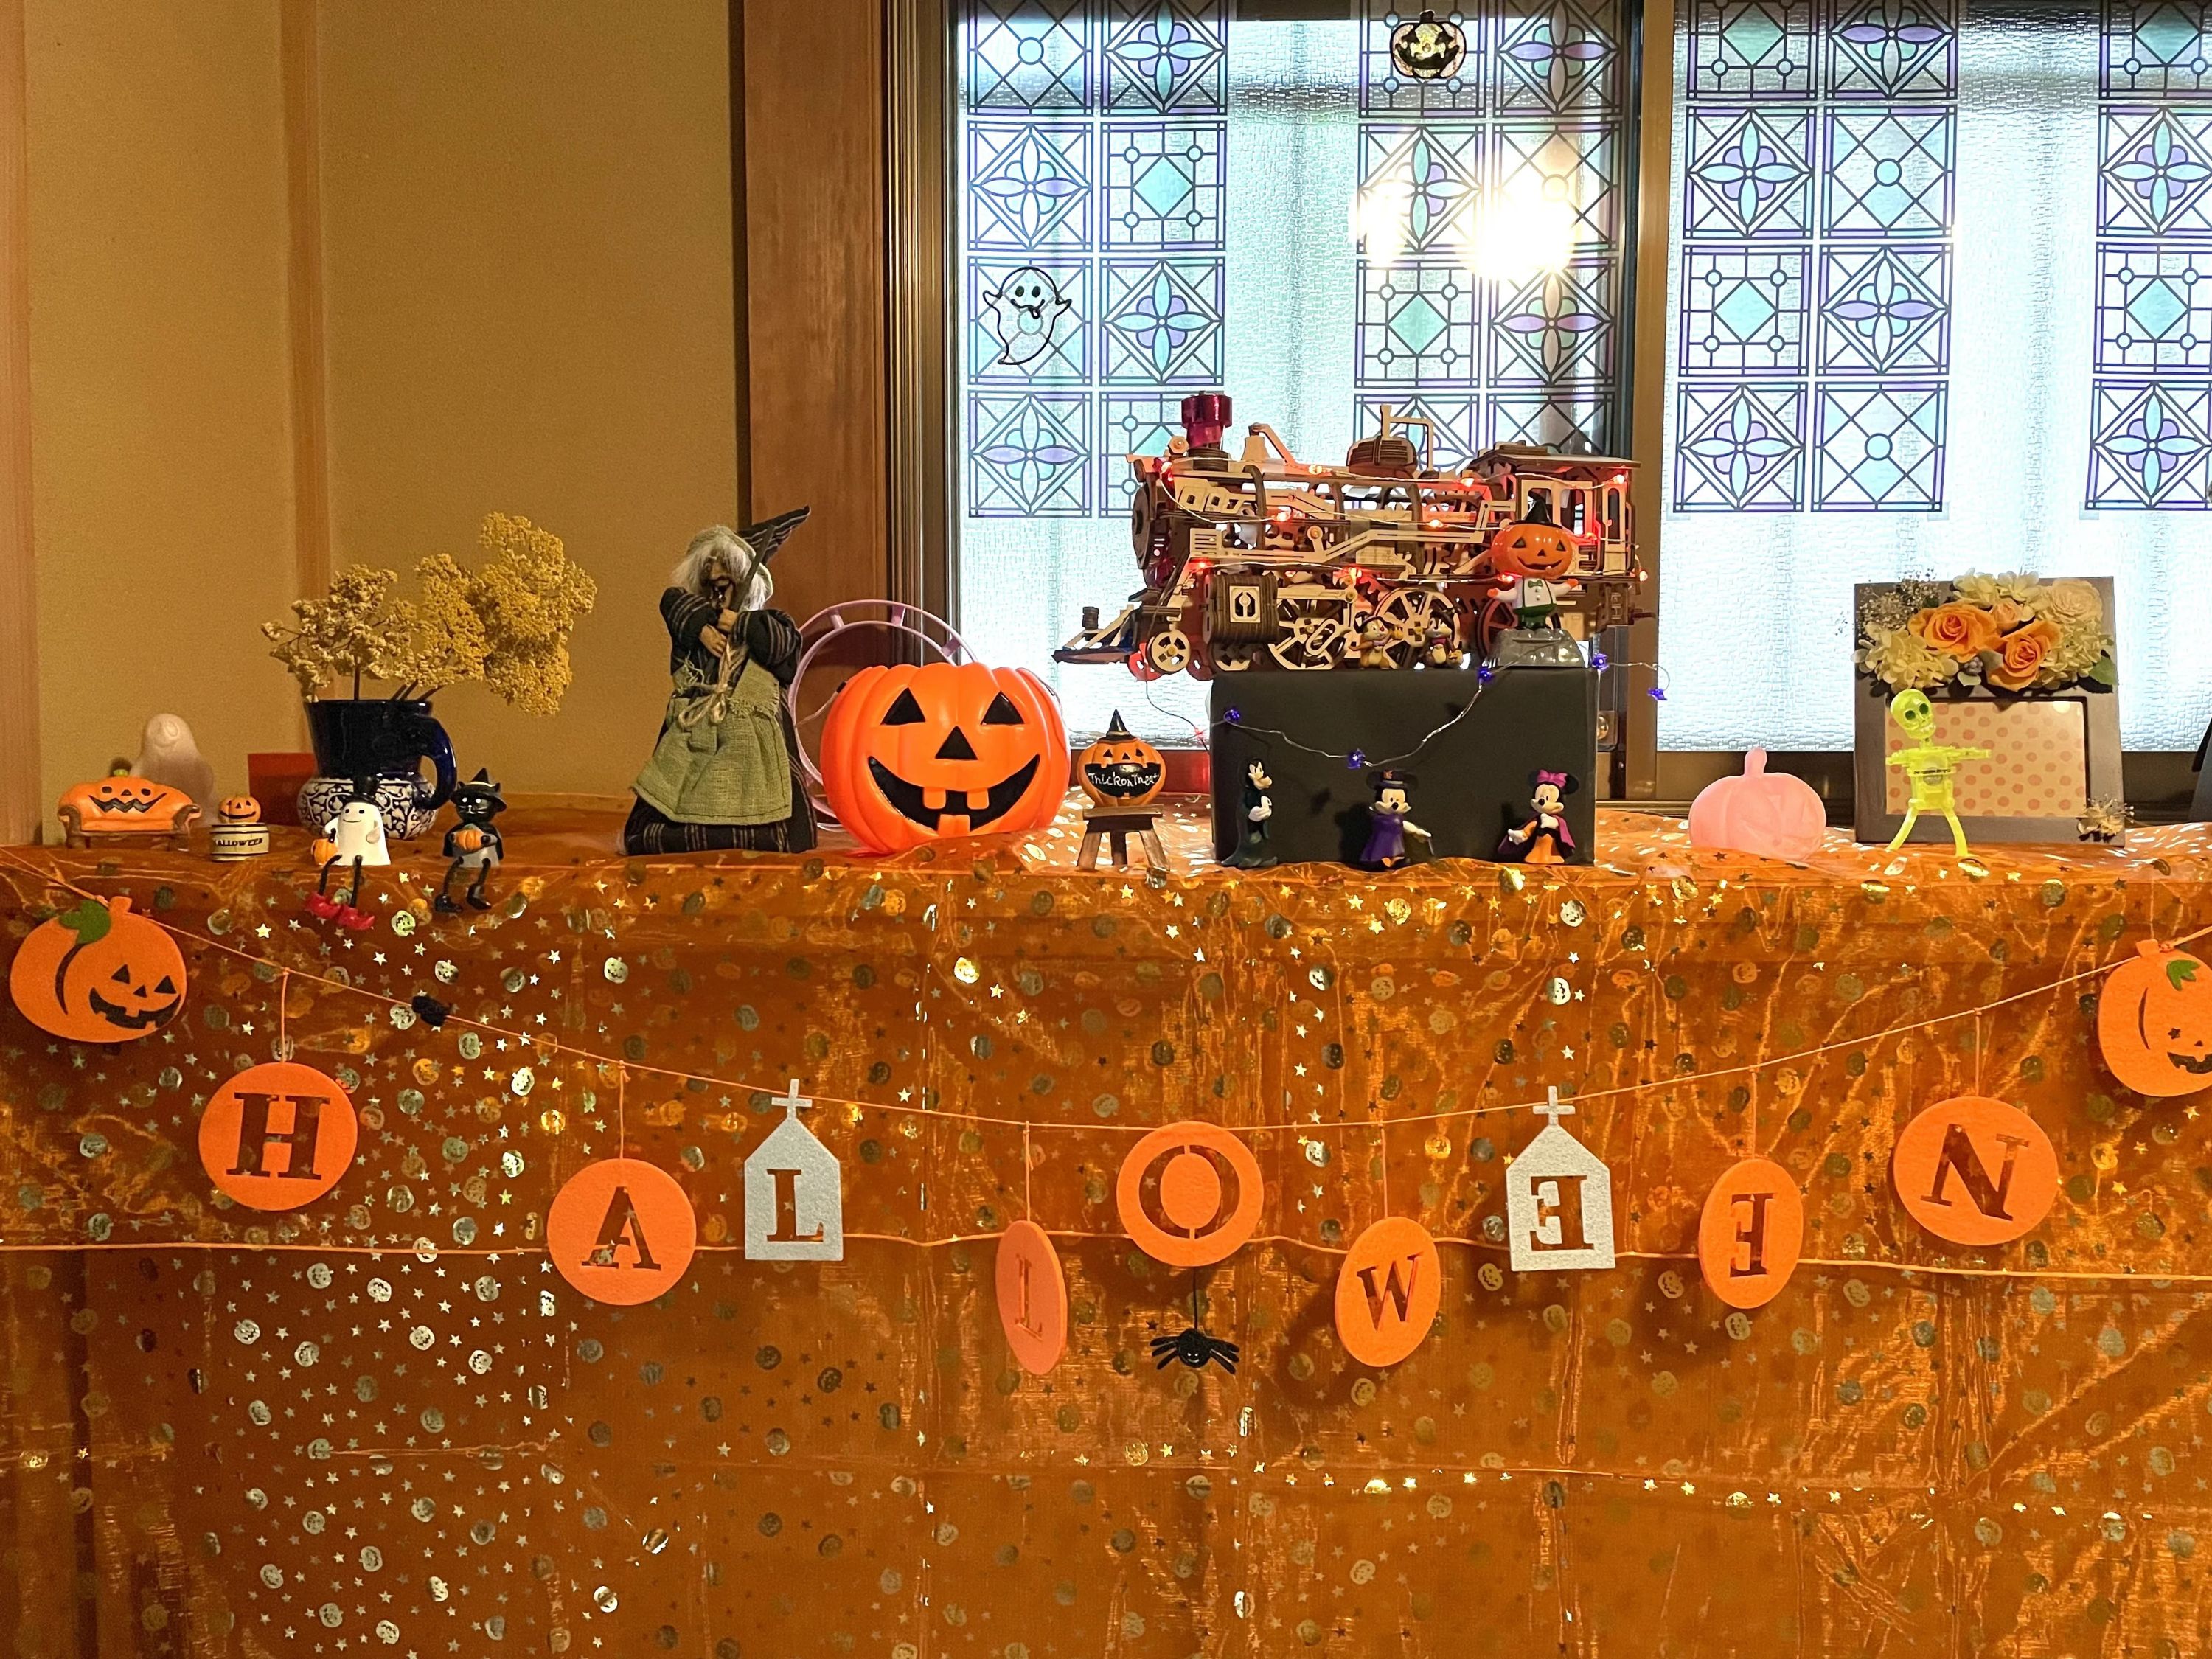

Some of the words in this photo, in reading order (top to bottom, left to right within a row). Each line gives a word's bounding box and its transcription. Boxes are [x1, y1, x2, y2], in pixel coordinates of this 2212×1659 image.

[215, 838, 263, 846] ALLOWEEN
[226, 1091, 330, 1180] H
[580, 1186, 662, 1271] A
[766, 1168, 824, 1243] L
[1139, 1144, 1241, 1239] O
[1357, 1253, 1424, 1332] W
[1921, 1122, 2031, 1222] N
